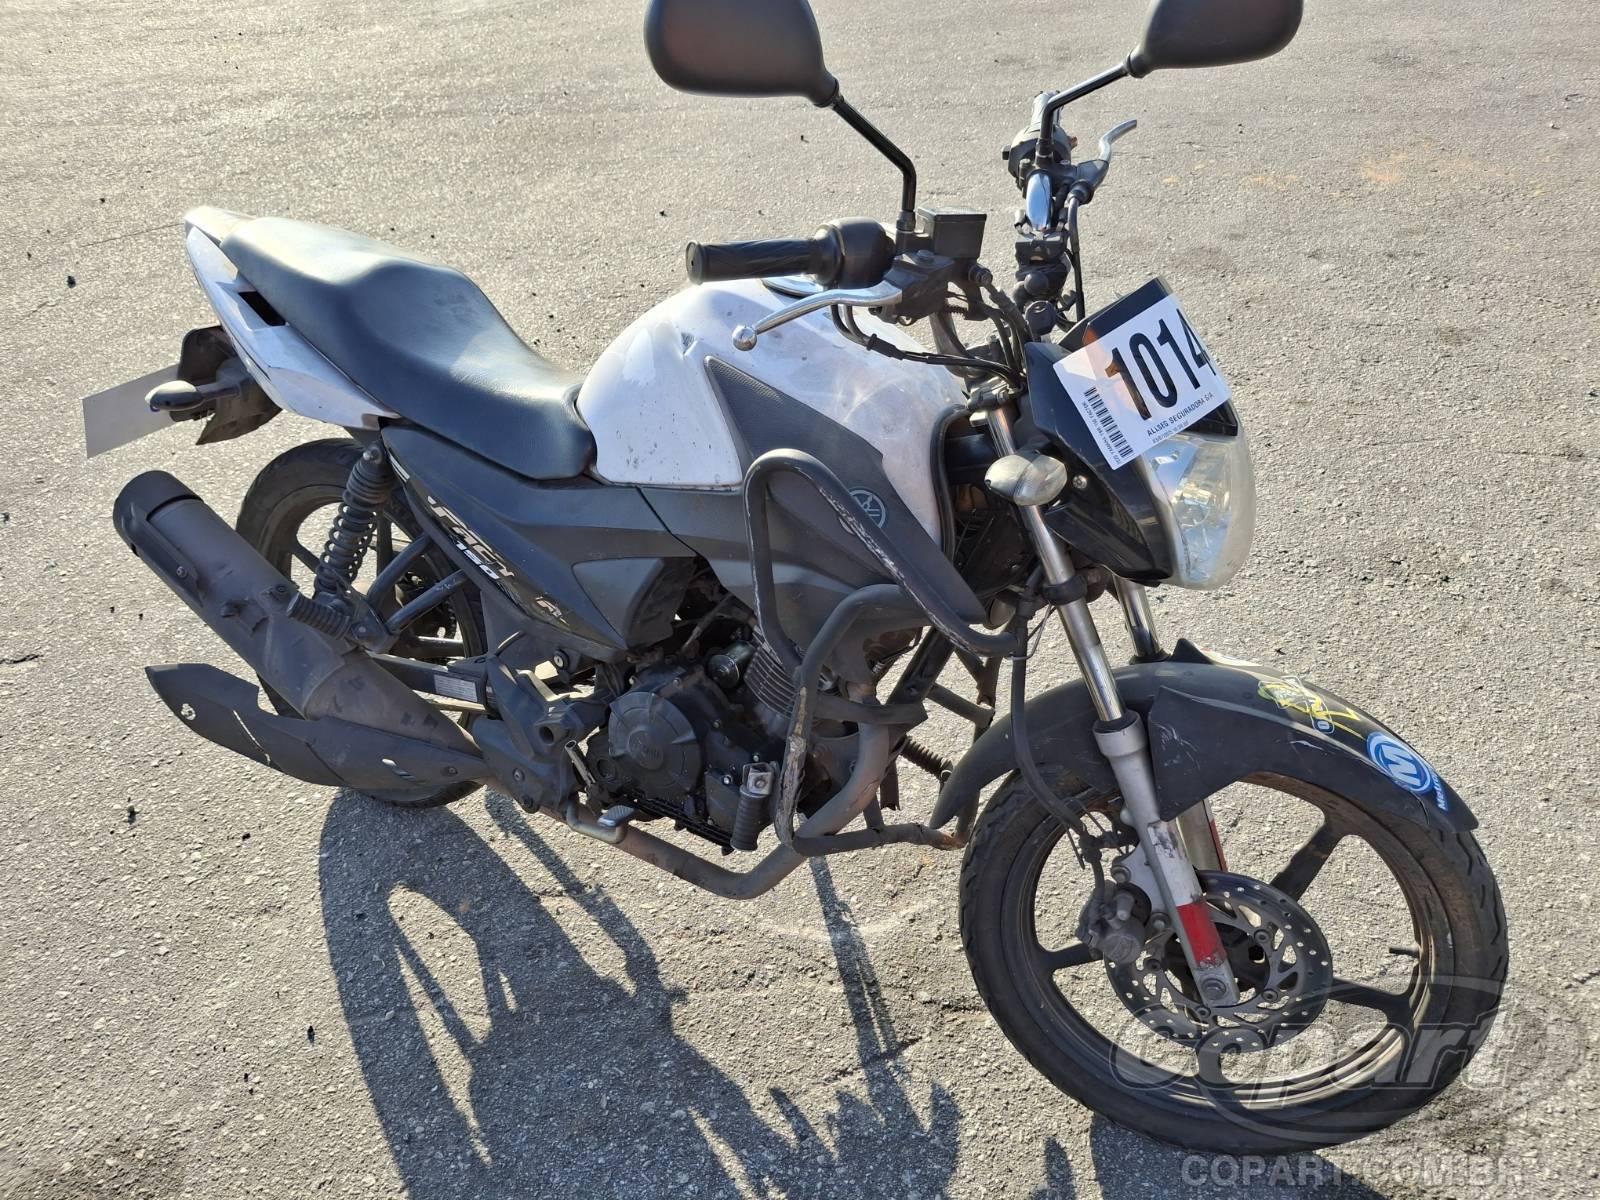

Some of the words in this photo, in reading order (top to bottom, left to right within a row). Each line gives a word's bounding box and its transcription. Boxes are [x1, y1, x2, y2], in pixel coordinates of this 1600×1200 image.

[1104, 308, 1216, 420] 1014
[1168, 397, 1206, 425] SEGURADORA
[455, 540, 500, 580] 150
